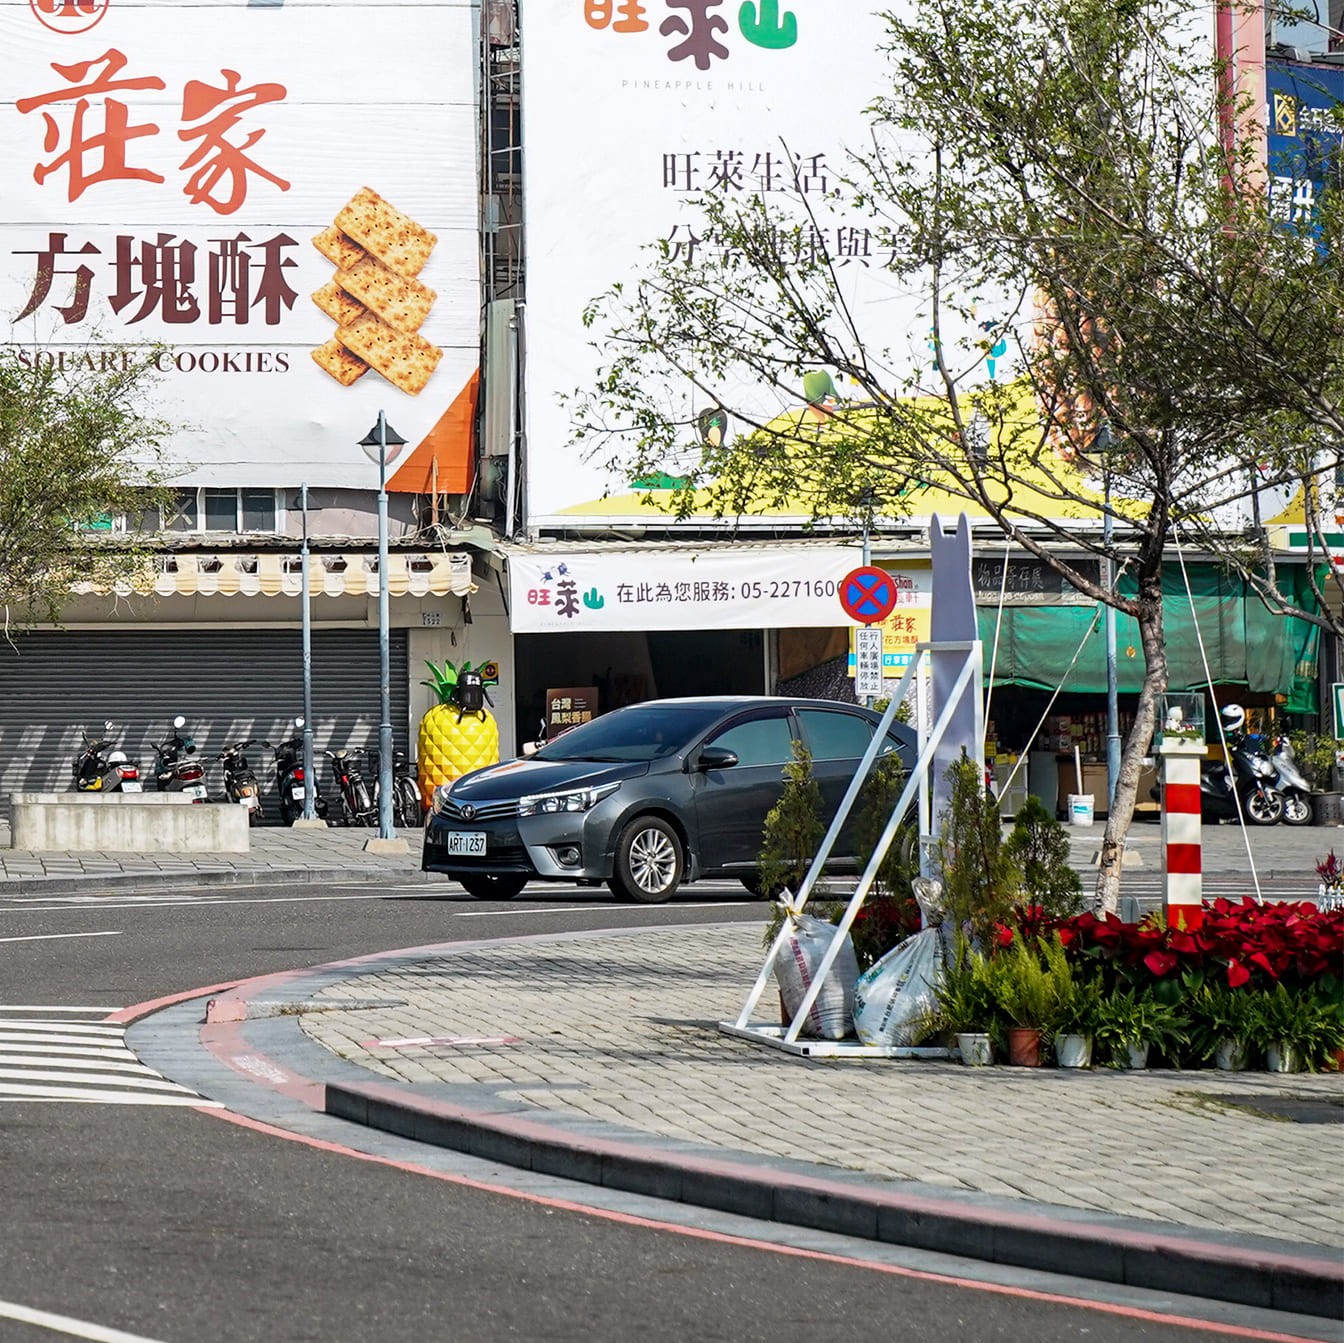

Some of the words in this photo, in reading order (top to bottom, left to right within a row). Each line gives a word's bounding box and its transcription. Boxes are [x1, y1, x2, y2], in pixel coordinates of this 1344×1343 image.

[622, 79, 712, 90] PINEAPPLE
[727, 82, 766, 92] HILL
[15, 47, 291, 216] 莊家
[11, 231, 300, 327] 方塊酥
[154, 351, 290, 373] COOKIES
